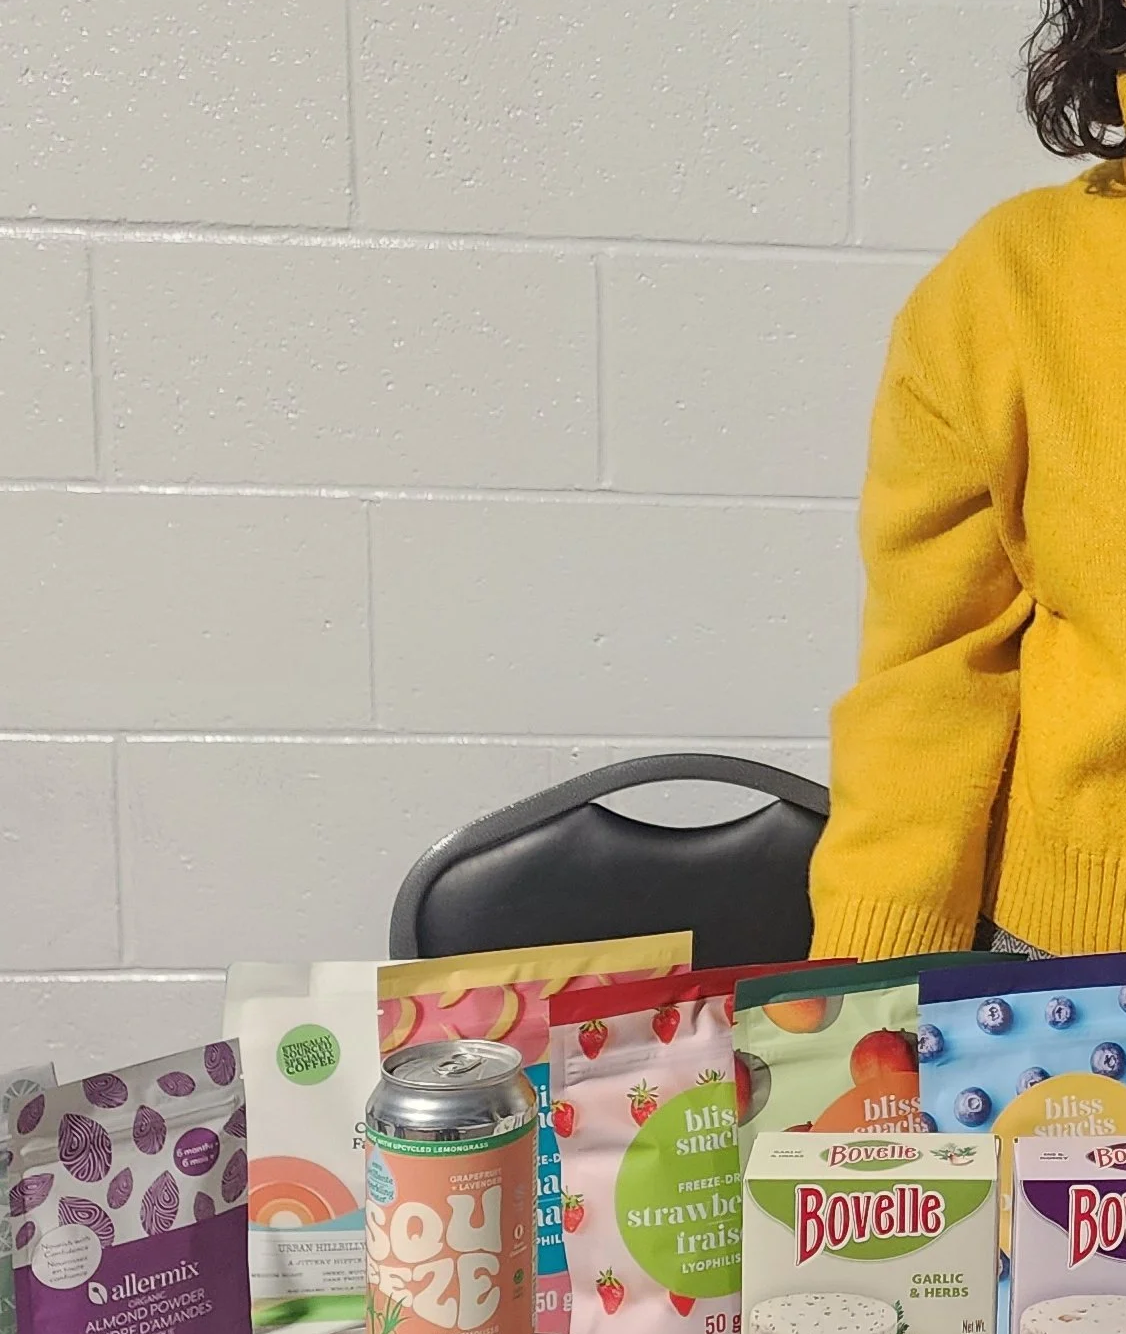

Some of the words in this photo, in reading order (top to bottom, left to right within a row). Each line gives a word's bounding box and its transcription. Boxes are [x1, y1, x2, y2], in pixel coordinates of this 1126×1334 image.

[286, 1057, 336, 1075] COFFEE
[863, 1095, 921, 1122] bliss
[1044, 1095, 1104, 1120] bliss
[392, 1142, 431, 1153] UPCYCLED
[433, 1142, 489, 1153] LEMONGRASS
[829, 1144, 921, 1168] Bovelle
[796, 1184, 945, 1266] Bovelle
[111, 1260, 200, 1301] allermix
[911, 1273, 964, 1285] GARLIC
[909, 1287, 920, 1299] &
[924, 1286, 969, 1298] HERBS
[85, 1307, 148, 1334] ALMOND
[150, 1288, 205, 1316] POWDER
